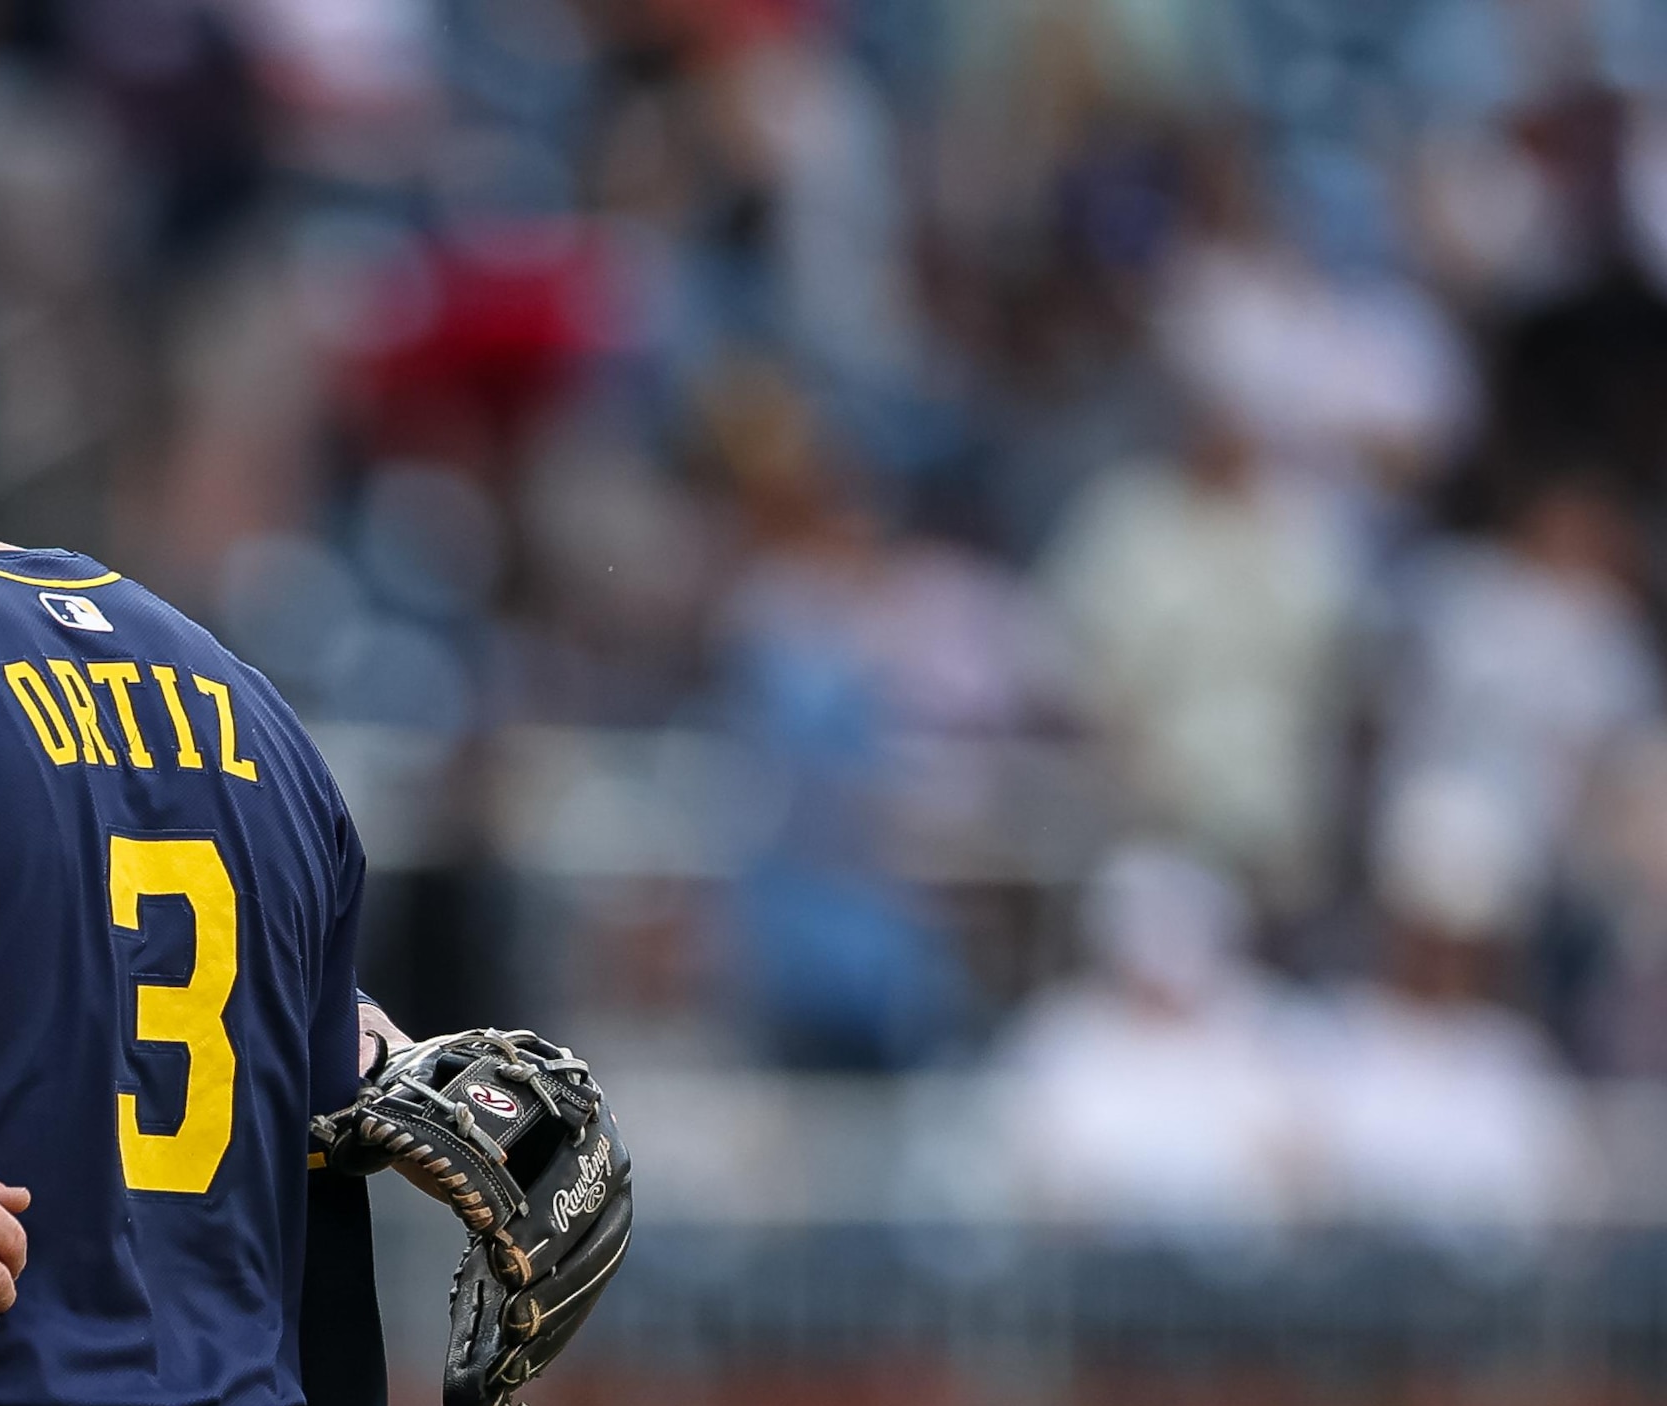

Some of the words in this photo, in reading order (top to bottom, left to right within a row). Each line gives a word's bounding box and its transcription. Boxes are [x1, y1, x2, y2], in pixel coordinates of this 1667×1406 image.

[3, 659, 259, 783] ORTIZ
[108, 835, 238, 1194] 3
[553, 1133, 612, 1233] Rawlings
